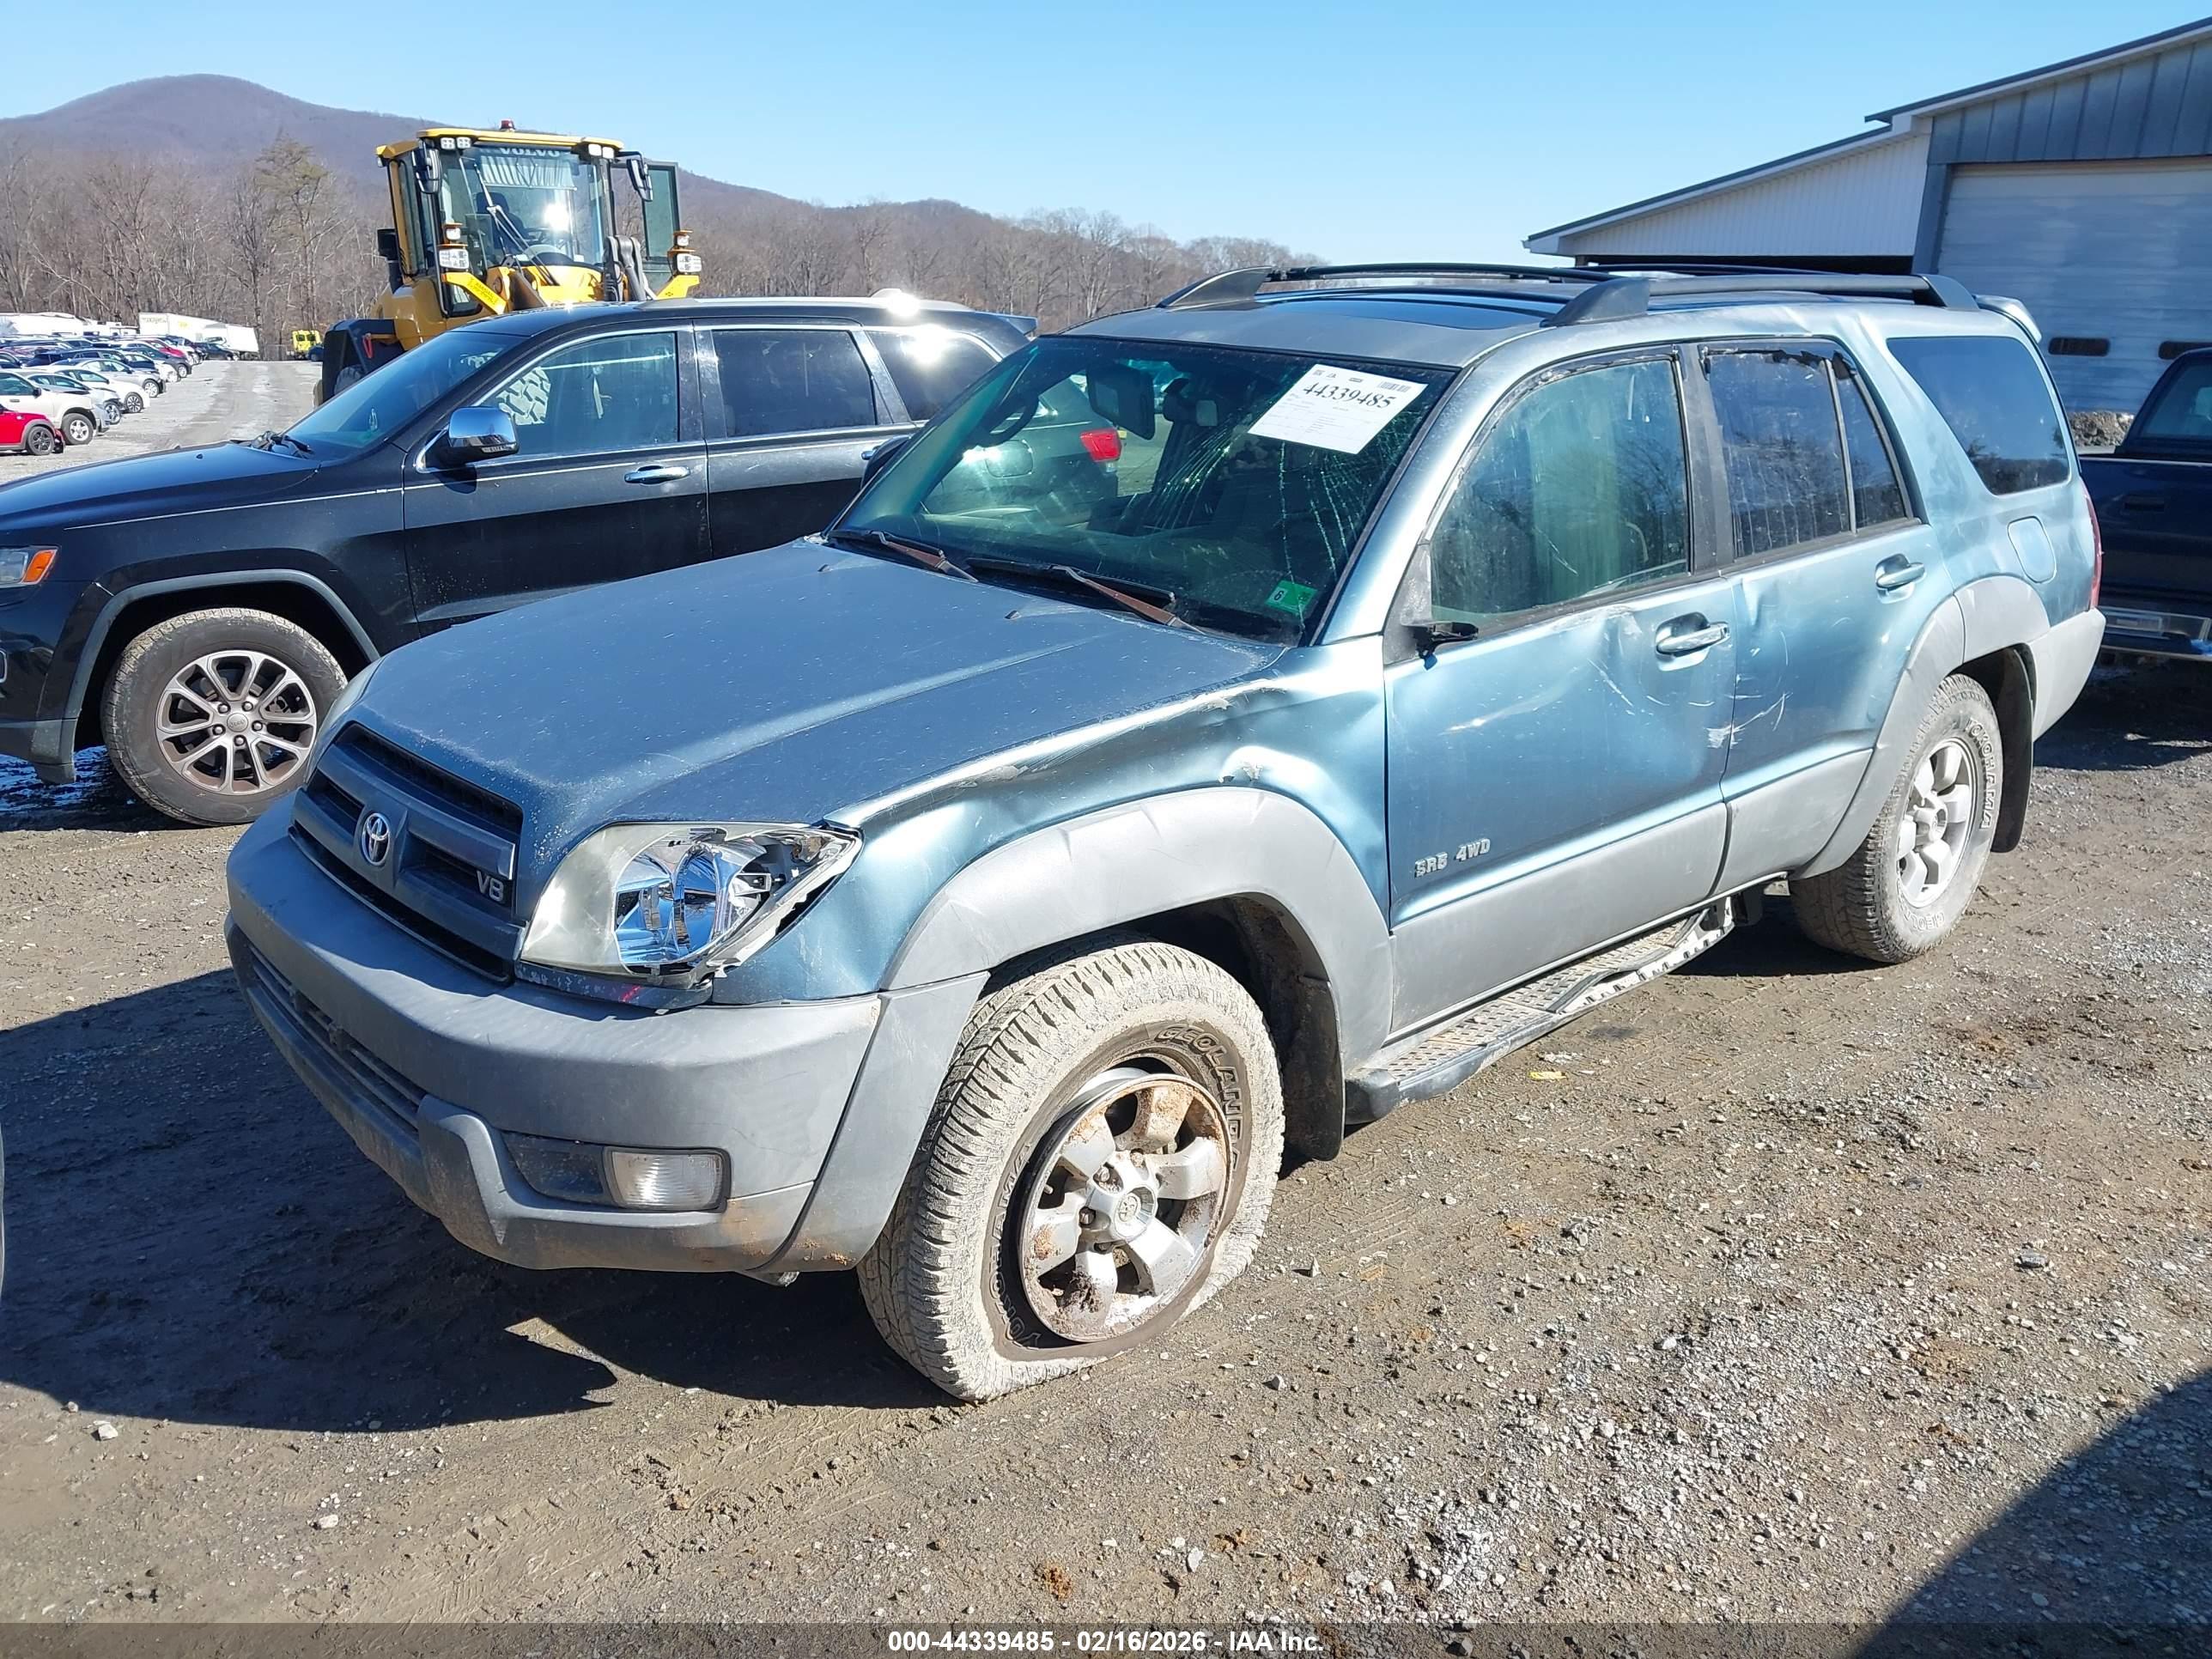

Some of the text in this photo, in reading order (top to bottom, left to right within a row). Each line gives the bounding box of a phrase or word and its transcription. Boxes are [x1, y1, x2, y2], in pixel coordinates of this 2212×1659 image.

[1303, 382, 1397, 409] 44339485
[1414, 838, 1491, 878] SR5 4WD
[476, 870, 504, 902] V8
